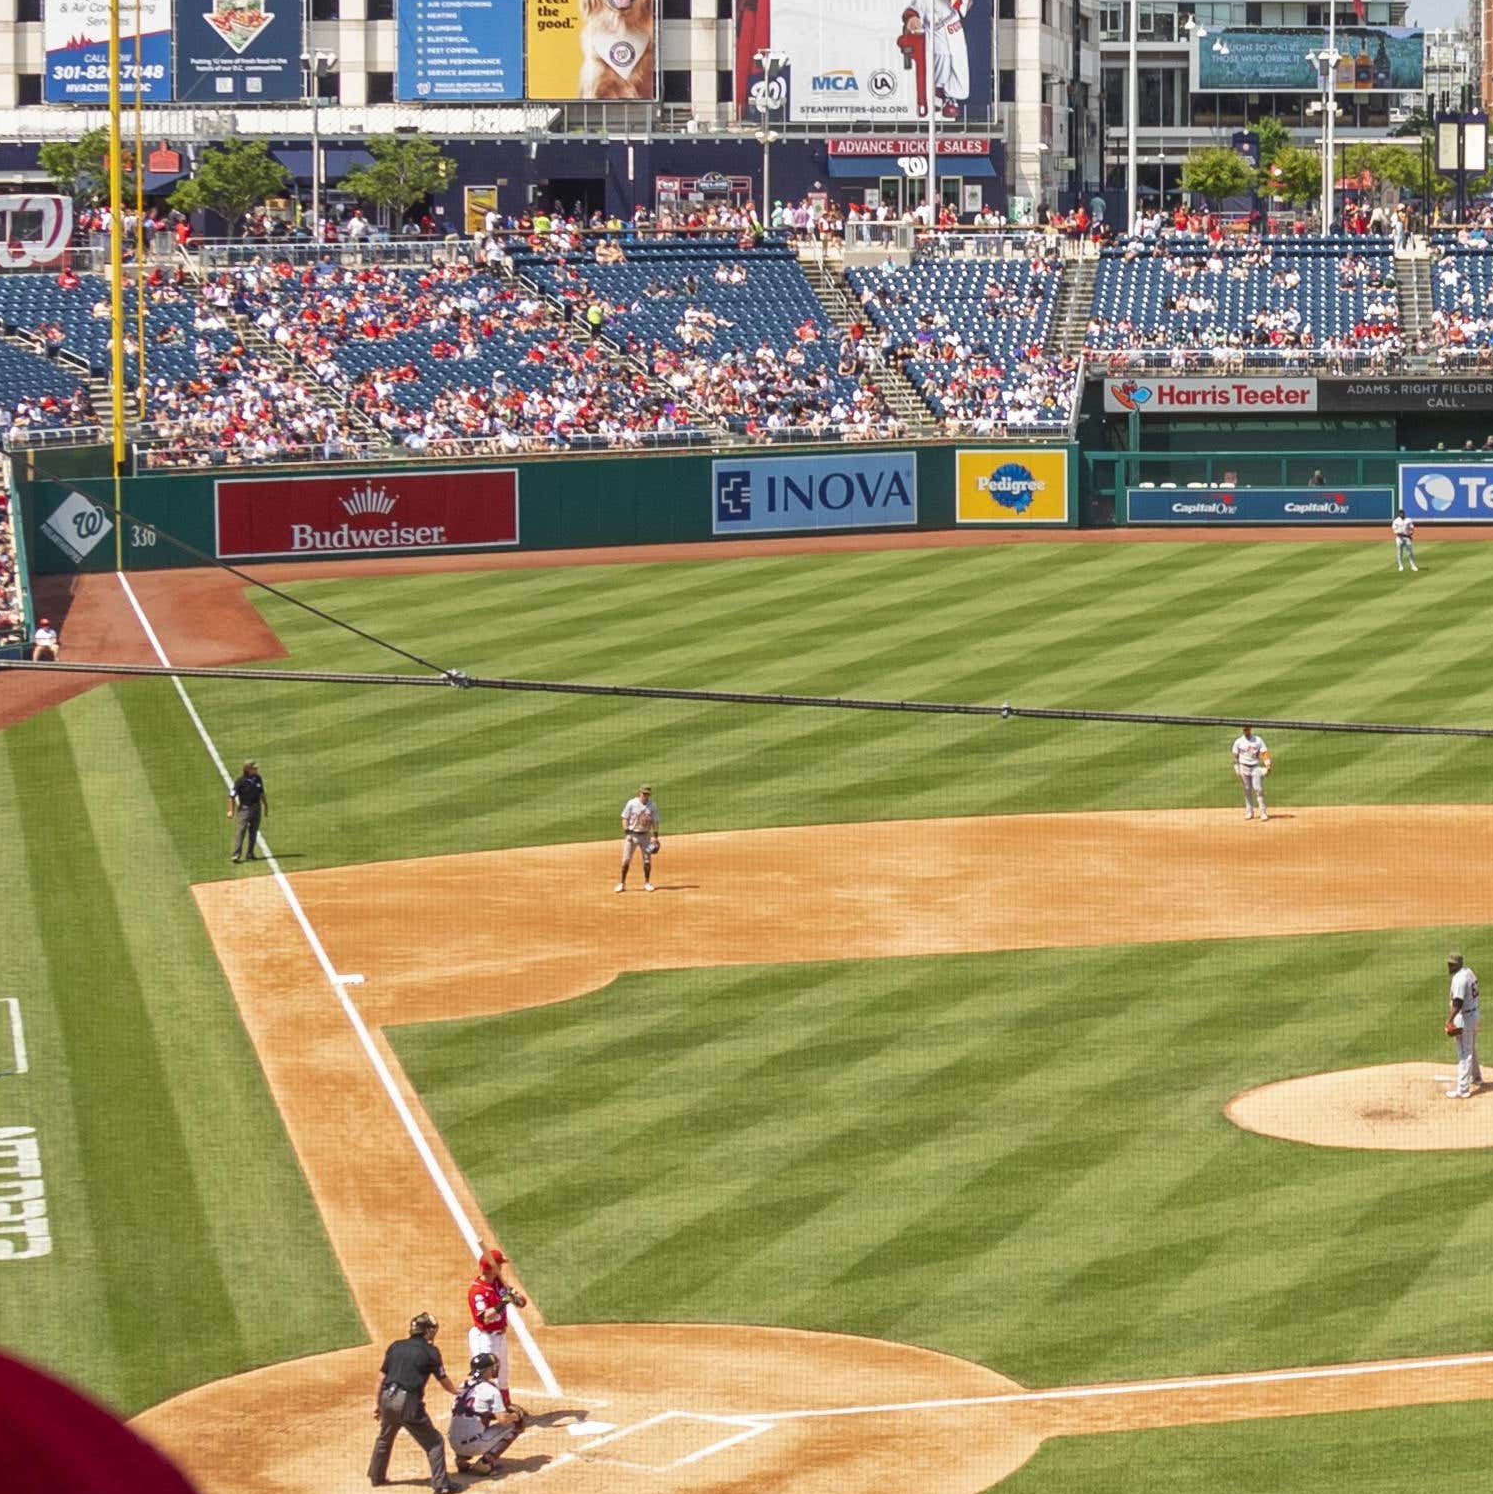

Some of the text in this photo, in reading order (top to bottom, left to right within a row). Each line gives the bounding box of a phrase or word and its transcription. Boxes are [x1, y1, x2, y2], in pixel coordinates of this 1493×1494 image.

[538, 6, 559, 17] the
[812, 76, 858, 90] MCA
[838, 139, 983, 153] ADVANCE TICKT SALES
[1157, 383, 1311, 406] Harris Teeter
[1347, 384, 1390, 394] ADAMS
[1401, 384, 1438, 394] RIGHT
[1442, 383, 1493, 394] FIELDER
[767, 471, 1045, 513] INOVA Pedigree
[292, 521, 445, 551] Budweiser
